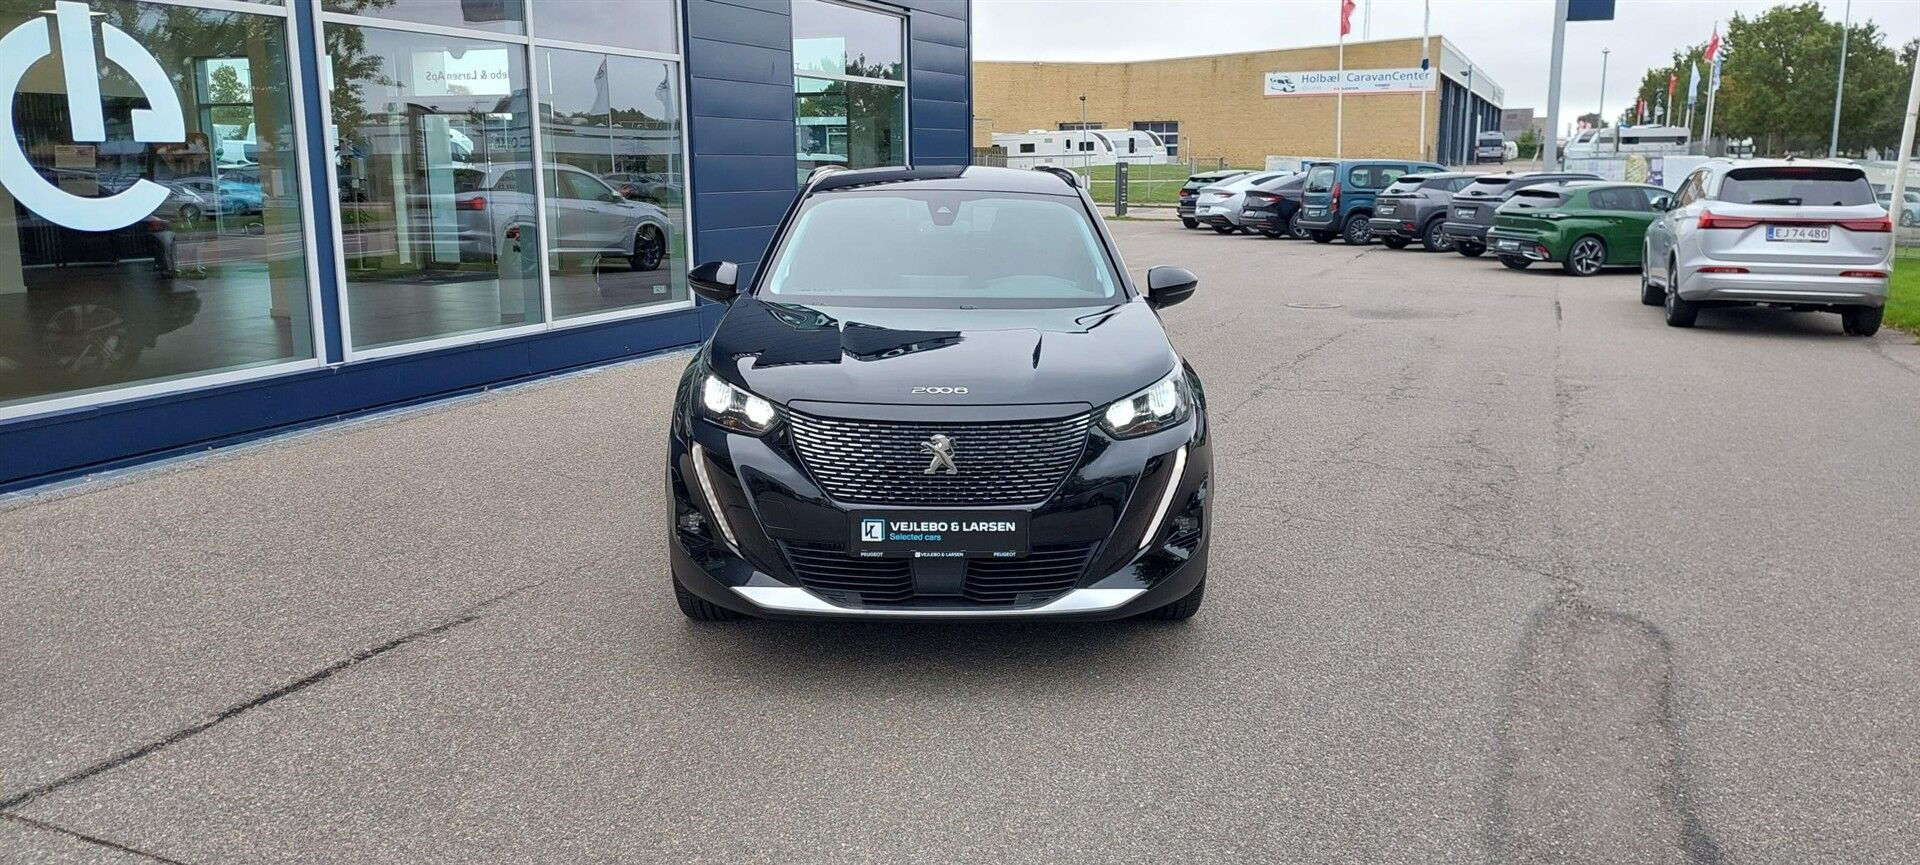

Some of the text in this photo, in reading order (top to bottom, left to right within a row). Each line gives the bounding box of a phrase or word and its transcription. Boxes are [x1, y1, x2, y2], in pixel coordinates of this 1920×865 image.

[1346, 71, 1430, 82] CaravanCenter
[1775, 228, 1828, 239] EJ 74 480
[911, 386, 969, 394] 2008
[889, 521, 1017, 532] VEJLEBO & LARSEN
[889, 532, 942, 542] Selected cars
